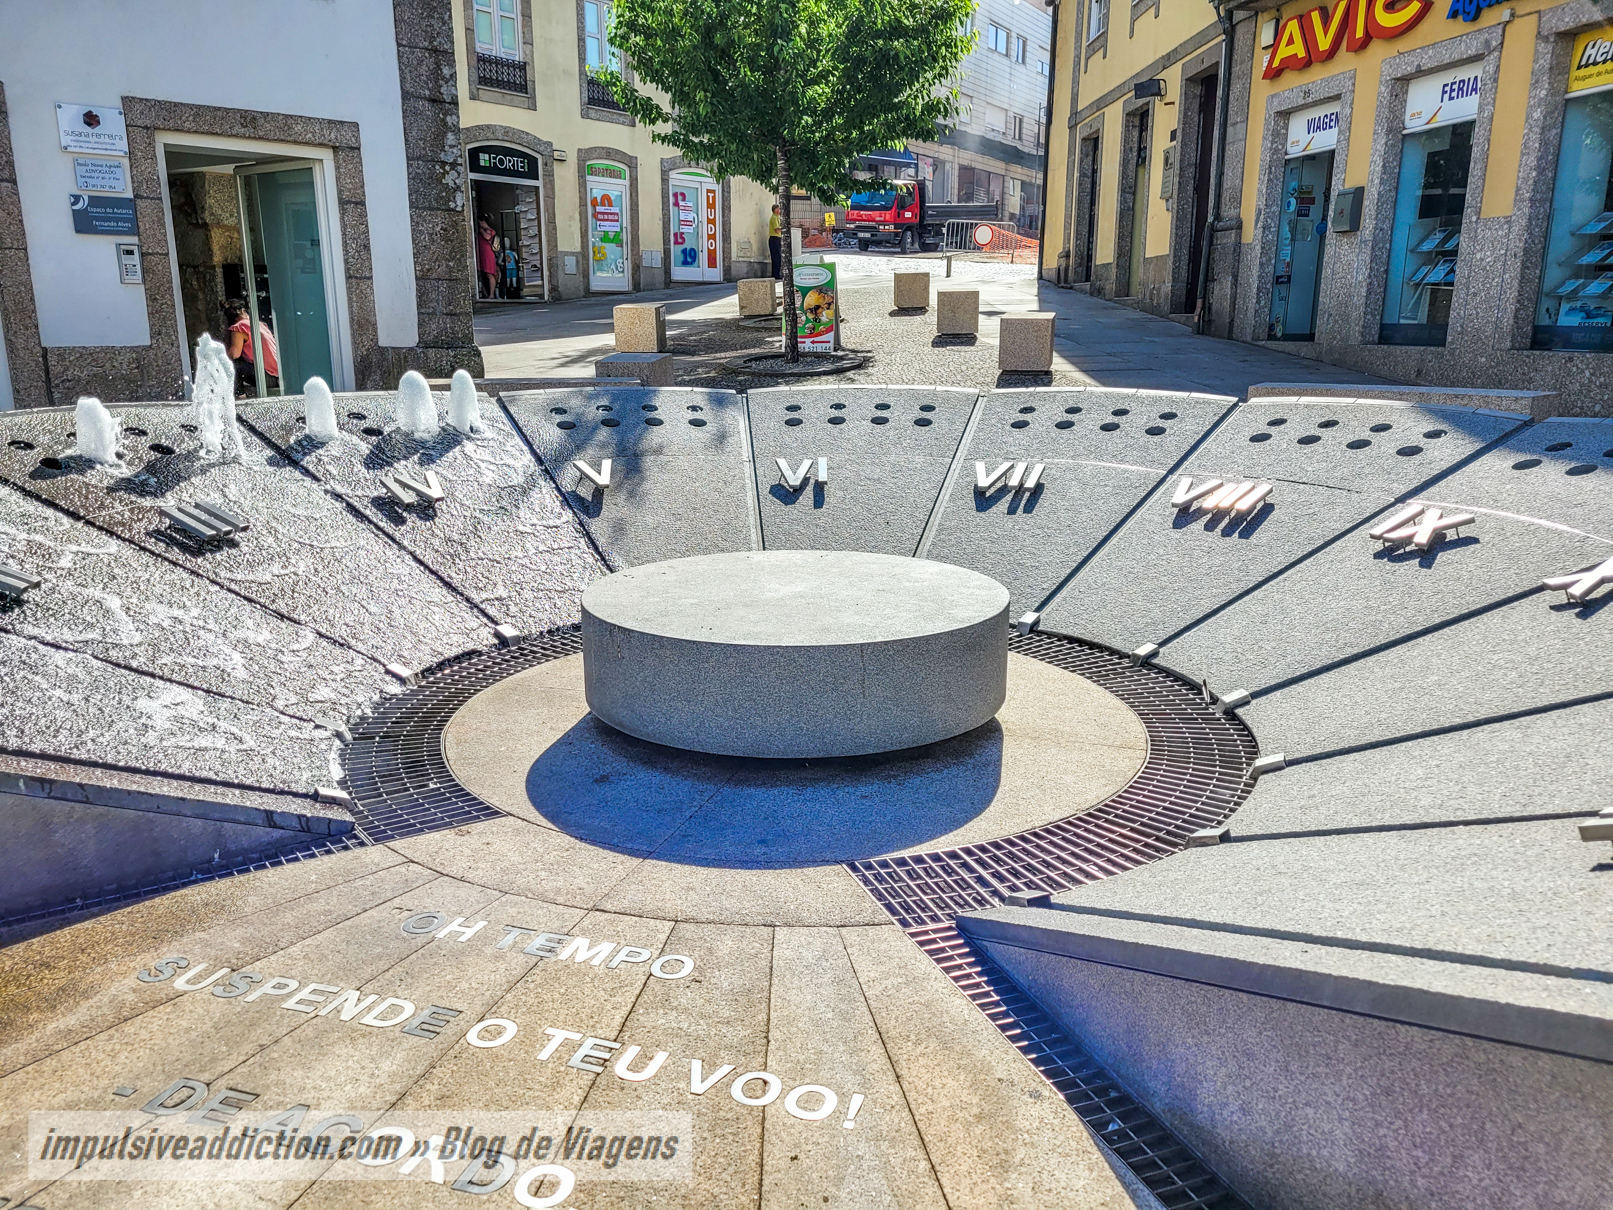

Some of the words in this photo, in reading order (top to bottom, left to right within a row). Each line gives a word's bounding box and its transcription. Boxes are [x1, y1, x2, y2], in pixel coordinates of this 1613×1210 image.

[1262, 0, 1433, 79] AVIC
[1596, 70, 1603, 78] de
[490, 154, 524, 172] FORTE
[673, 231, 686, 246] 15
[707, 192, 716, 250] TUDO
[680, 247, 697, 266] 19
[379, 470, 445, 506] IV
[572, 458, 612, 489] V
[776, 457, 828, 490] VI
[975, 461, 1046, 492] VII
[1171, 477, 1273, 512] VIII
[1369, 503, 1476, 549] IX
[401, 911, 488, 942] OH
[495, 925, 695, 980] TEMPO
[137, 956, 464, 1040] SUSPENDE
[465, 1018, 518, 1048] O
[536, 1027, 670, 1082] TEU
[689, 1058, 865, 1130] VOO!
[140, 1077, 262, 1129] DE
[242, 1103, 576, 1208] ACORDO
